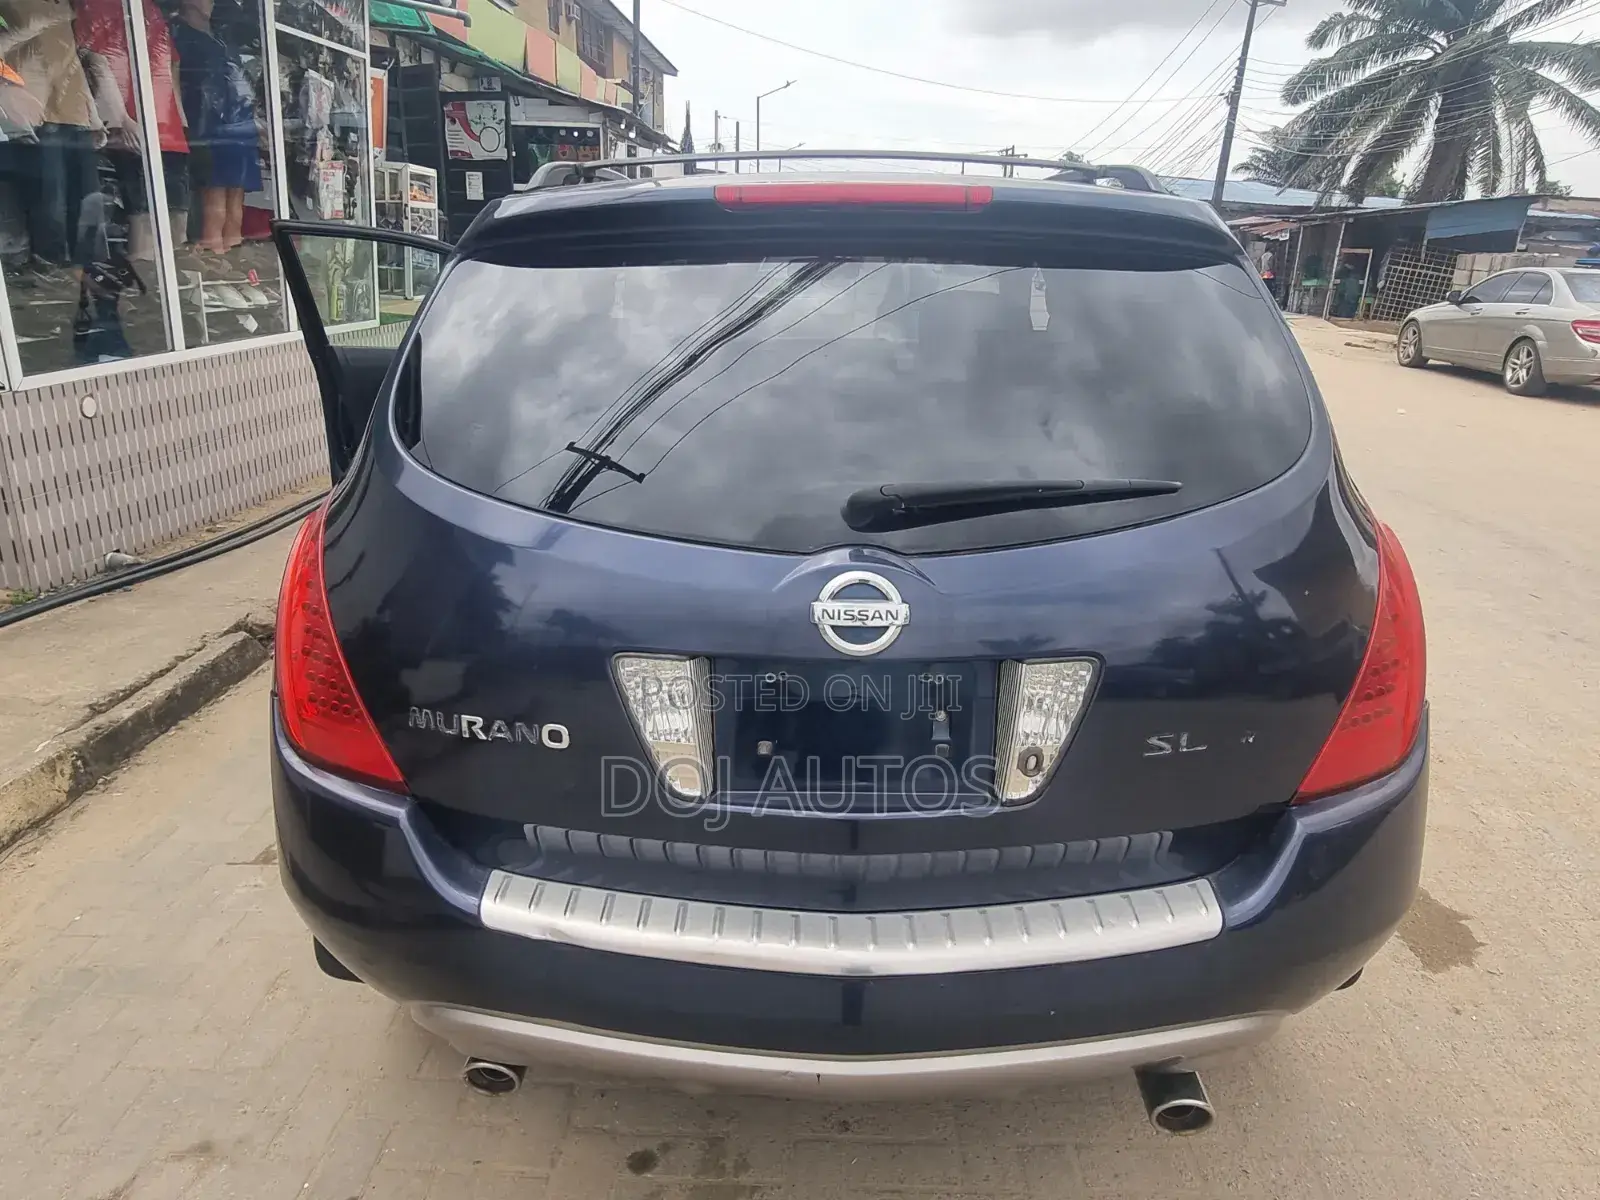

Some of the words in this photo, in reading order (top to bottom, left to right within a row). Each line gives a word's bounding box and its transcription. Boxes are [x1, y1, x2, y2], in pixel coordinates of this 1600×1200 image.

[821, 608, 899, 621] NISSAN
[408, 706, 570, 749] MURANO
[1143, 732, 1208, 757] SL
